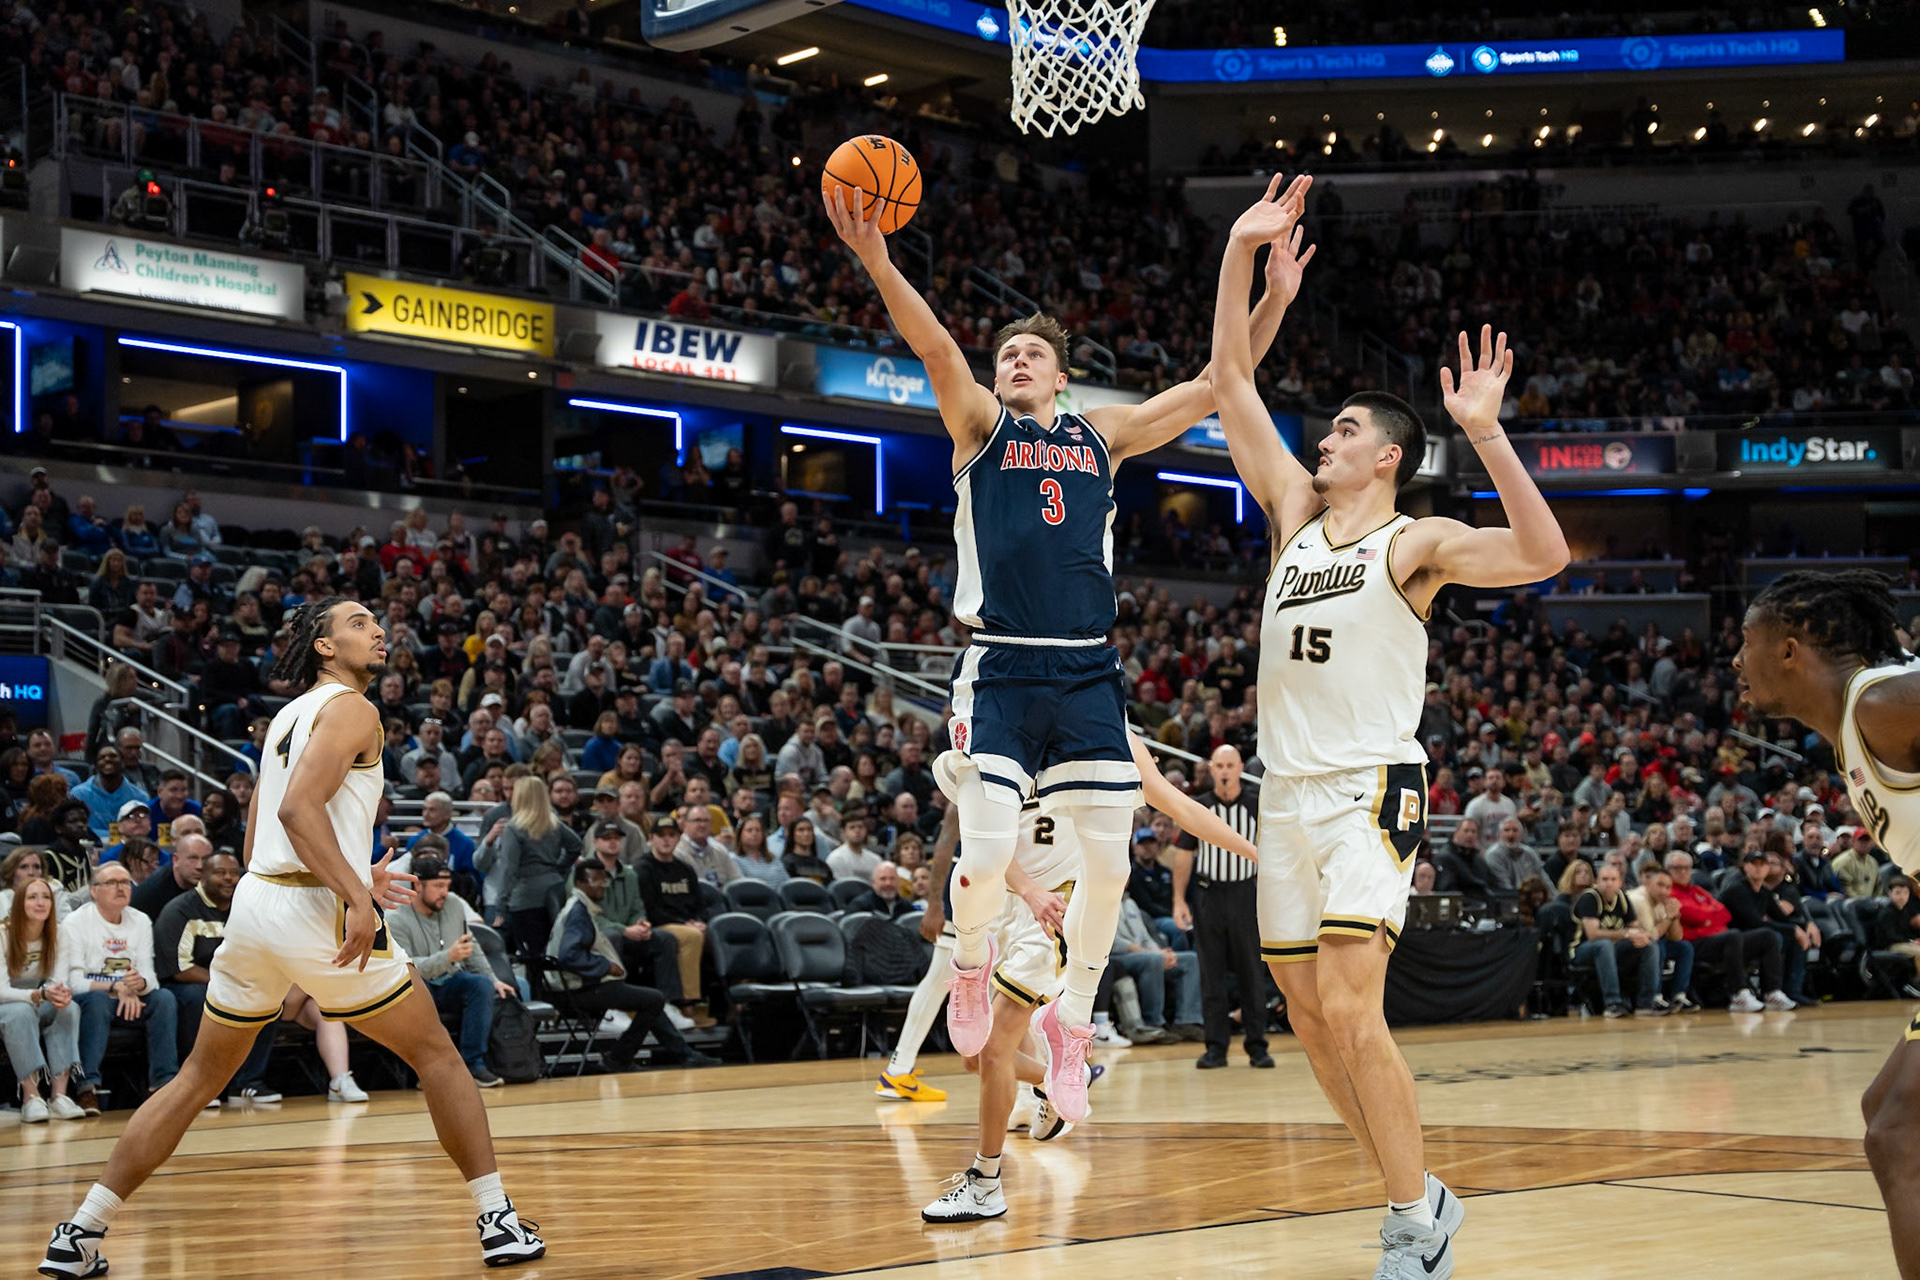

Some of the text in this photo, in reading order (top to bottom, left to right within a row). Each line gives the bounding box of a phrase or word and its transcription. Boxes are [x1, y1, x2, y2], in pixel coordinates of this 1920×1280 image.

[1259, 52, 1387, 74] Sports Tech HQ
[1500, 49, 1579, 66] Sports Tech HQ
[1671, 38, 1800, 60] Sports Tech HQ
[135, 243, 261, 279] Peyton Manning
[135, 263, 278, 297] Children's Hospital
[393, 294, 545, 344] GAINBRIDGE
[633, 320, 743, 364] IBEW
[632, 355, 696, 377] LOCAL
[865, 356, 926, 406] Kroger
[1540, 446, 1572, 470] IN
[1741, 437, 1877, 466] IndyStar.
[1039, 477, 1066, 526] 3
[1275, 560, 1367, 603] Purdue
[1289, 624, 1333, 665] 15
[14, 683, 43, 700] HQ
[275, 715, 300, 770] 4
[1033, 815, 1056, 846] 2
